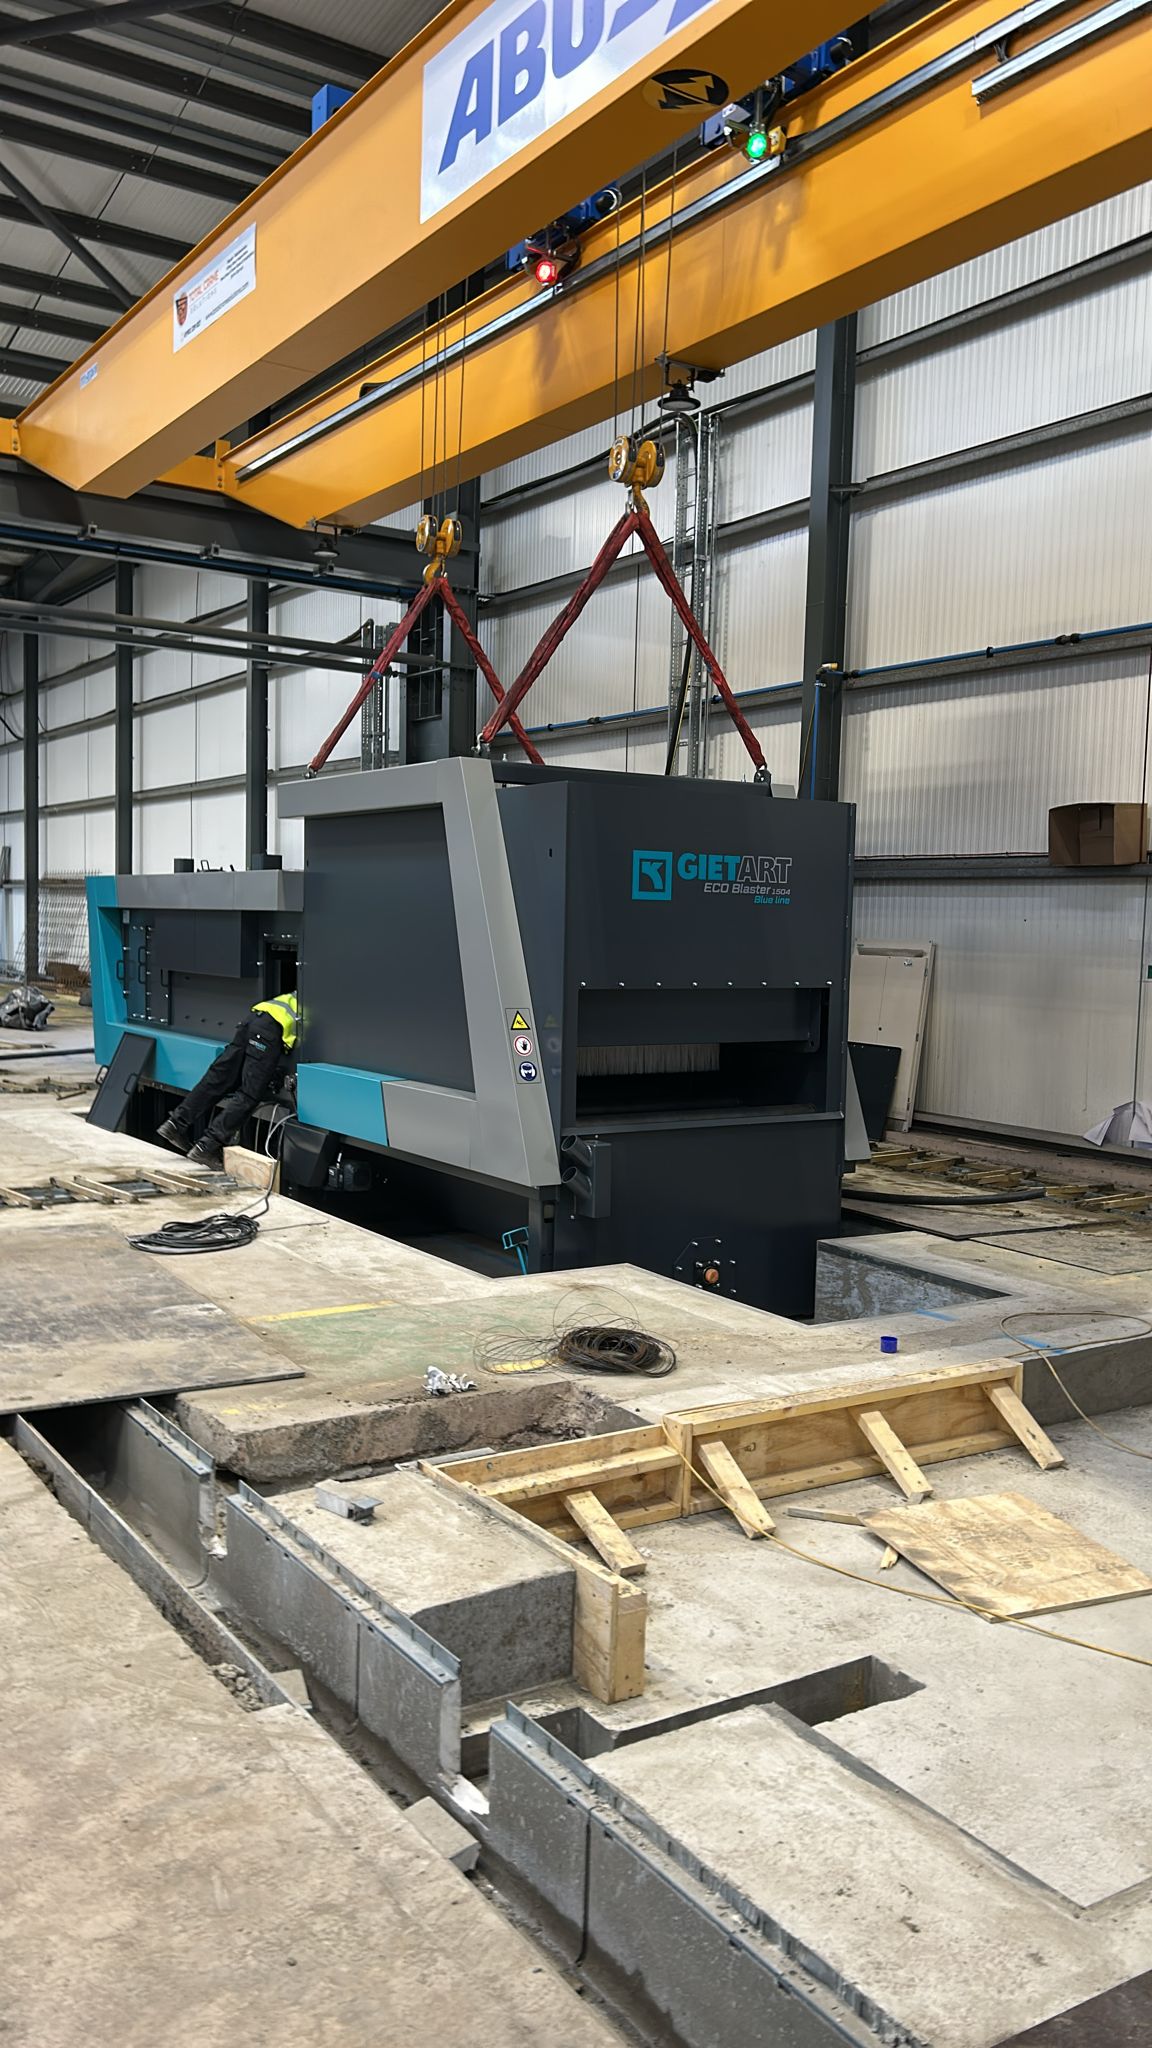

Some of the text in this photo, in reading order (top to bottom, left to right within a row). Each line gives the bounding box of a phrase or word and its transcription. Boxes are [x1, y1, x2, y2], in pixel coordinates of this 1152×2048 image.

[677, 852, 792, 884] GIETART
[704, 882, 791, 896] ECO Blaster 1504
[754, 895, 791, 905] Blue line
